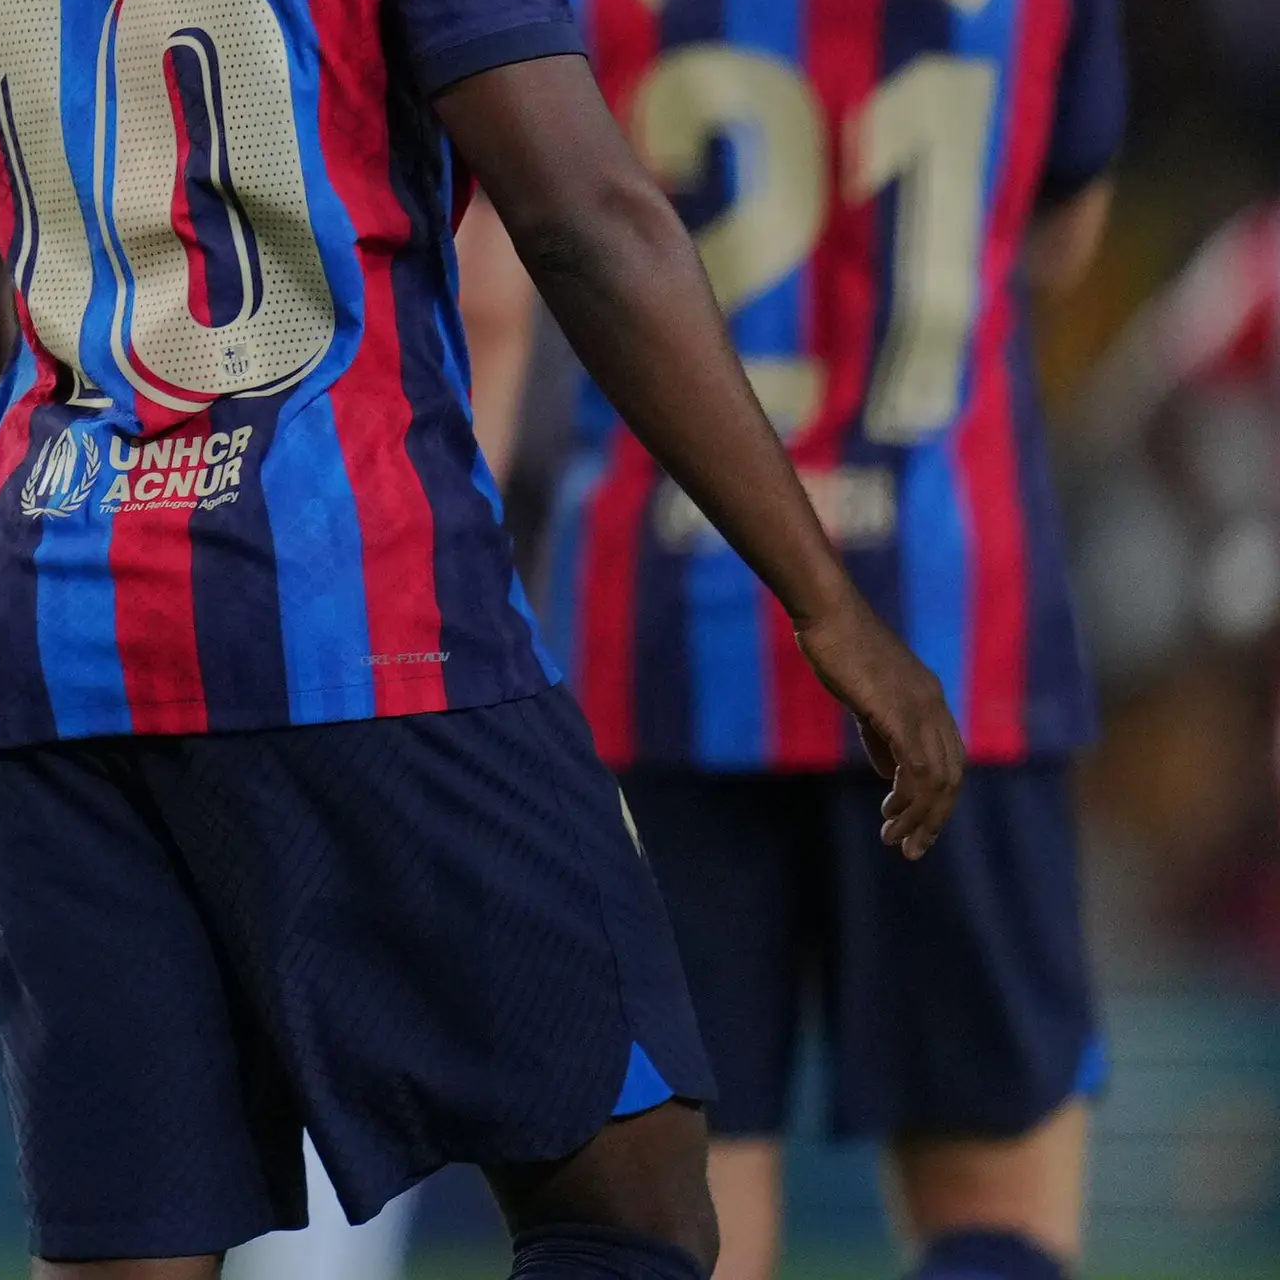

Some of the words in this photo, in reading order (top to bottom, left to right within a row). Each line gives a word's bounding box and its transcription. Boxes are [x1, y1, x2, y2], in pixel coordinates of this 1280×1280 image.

[628, 42, 998, 446] 21
[108, 424, 253, 472] UNHCR
[101, 456, 243, 503] ACNUR
[99, 503, 122, 514] The
[123, 502, 145, 513] UN
[144, 499, 198, 512] Refugee
